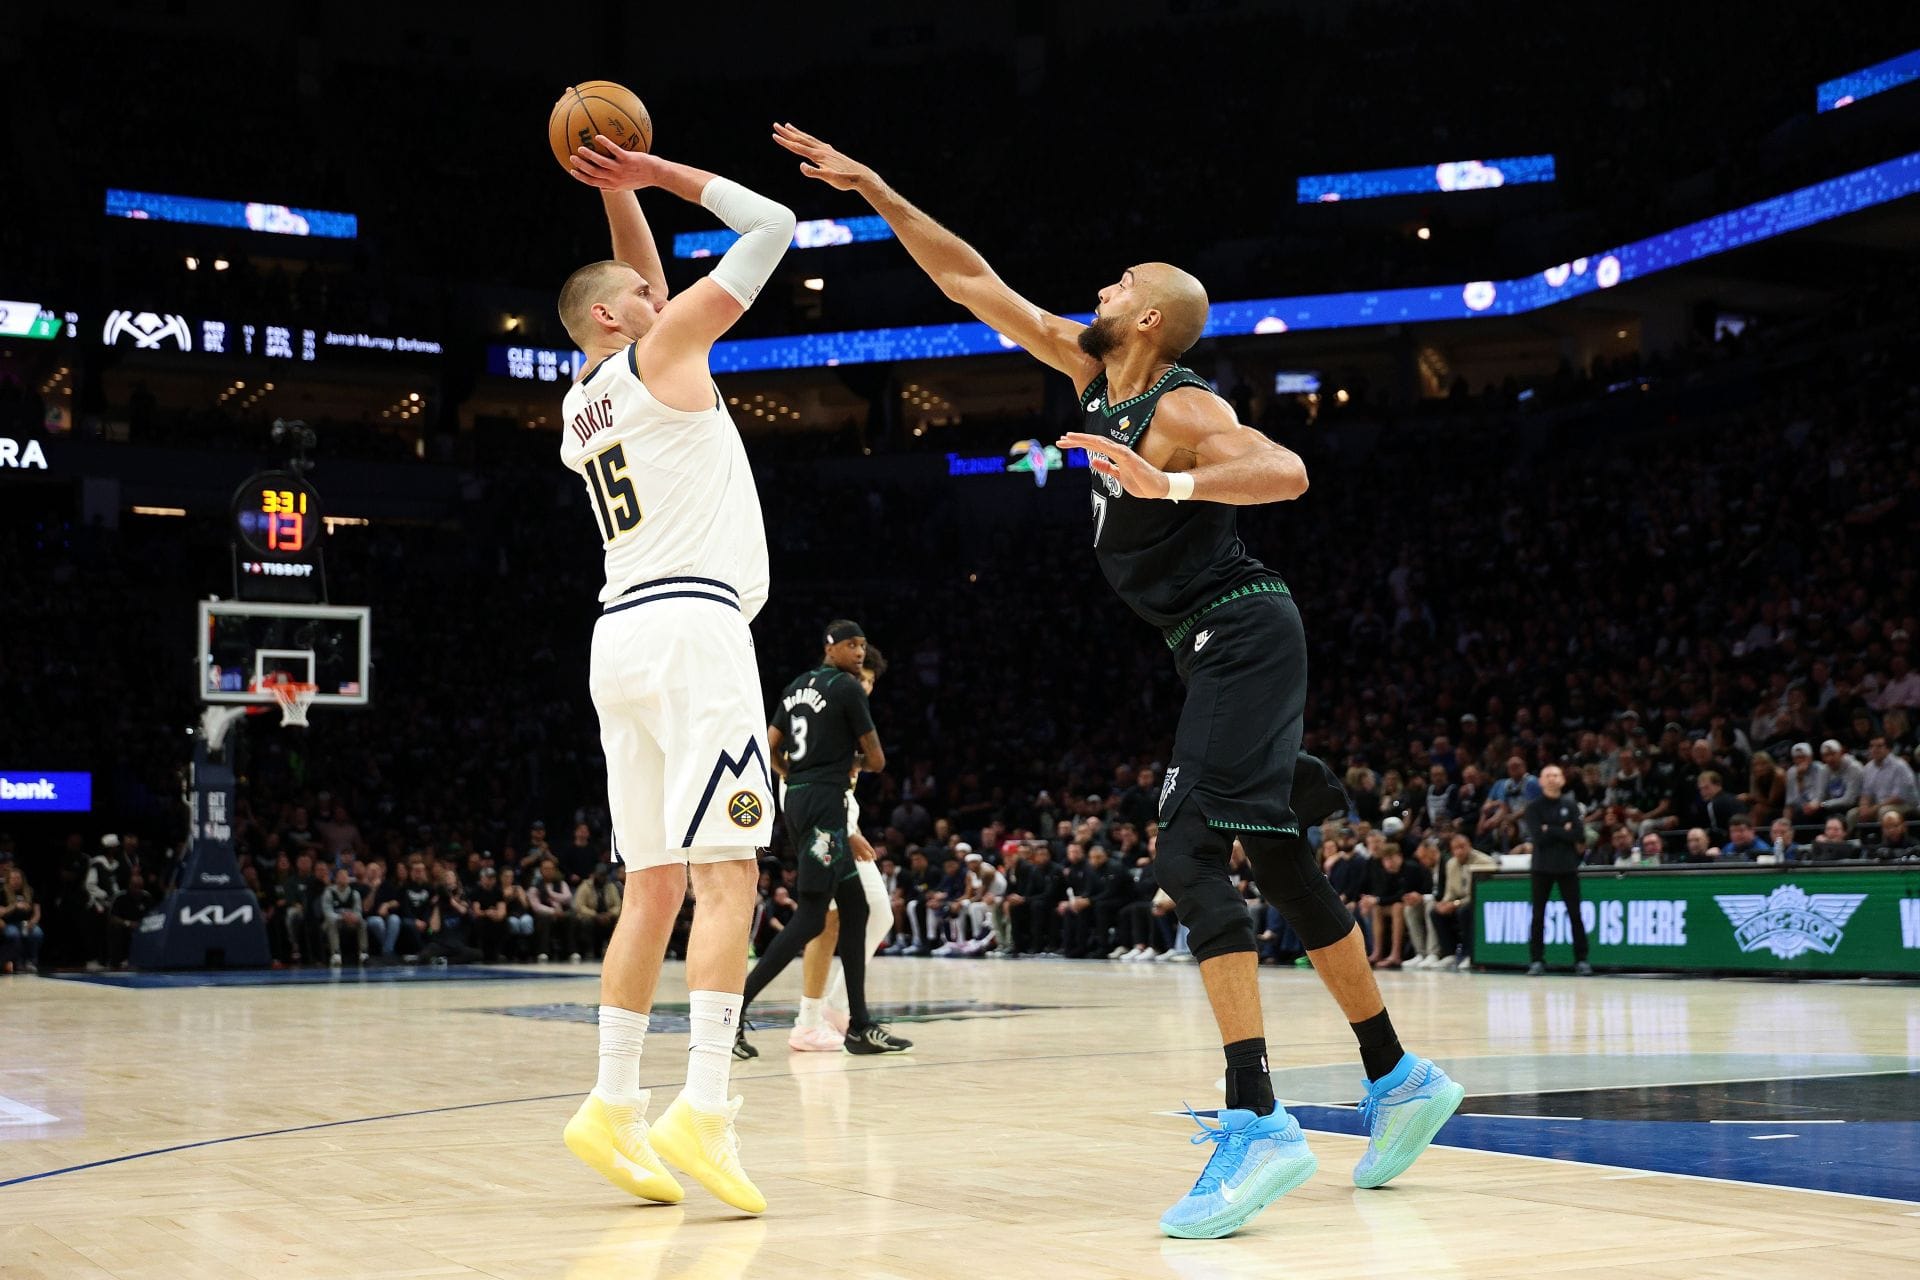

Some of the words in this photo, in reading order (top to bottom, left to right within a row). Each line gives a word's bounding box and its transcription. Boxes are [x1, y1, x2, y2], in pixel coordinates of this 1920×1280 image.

[572, 393, 613, 447] JOKIĆ
[584, 440, 642, 541] 15
[268, 512, 303, 551] 13
[789, 713, 809, 761] 3
[1484, 900, 1596, 945] WINSTP
[1600, 900, 1624, 945] IS
[1627, 900, 1688, 946] HERE
